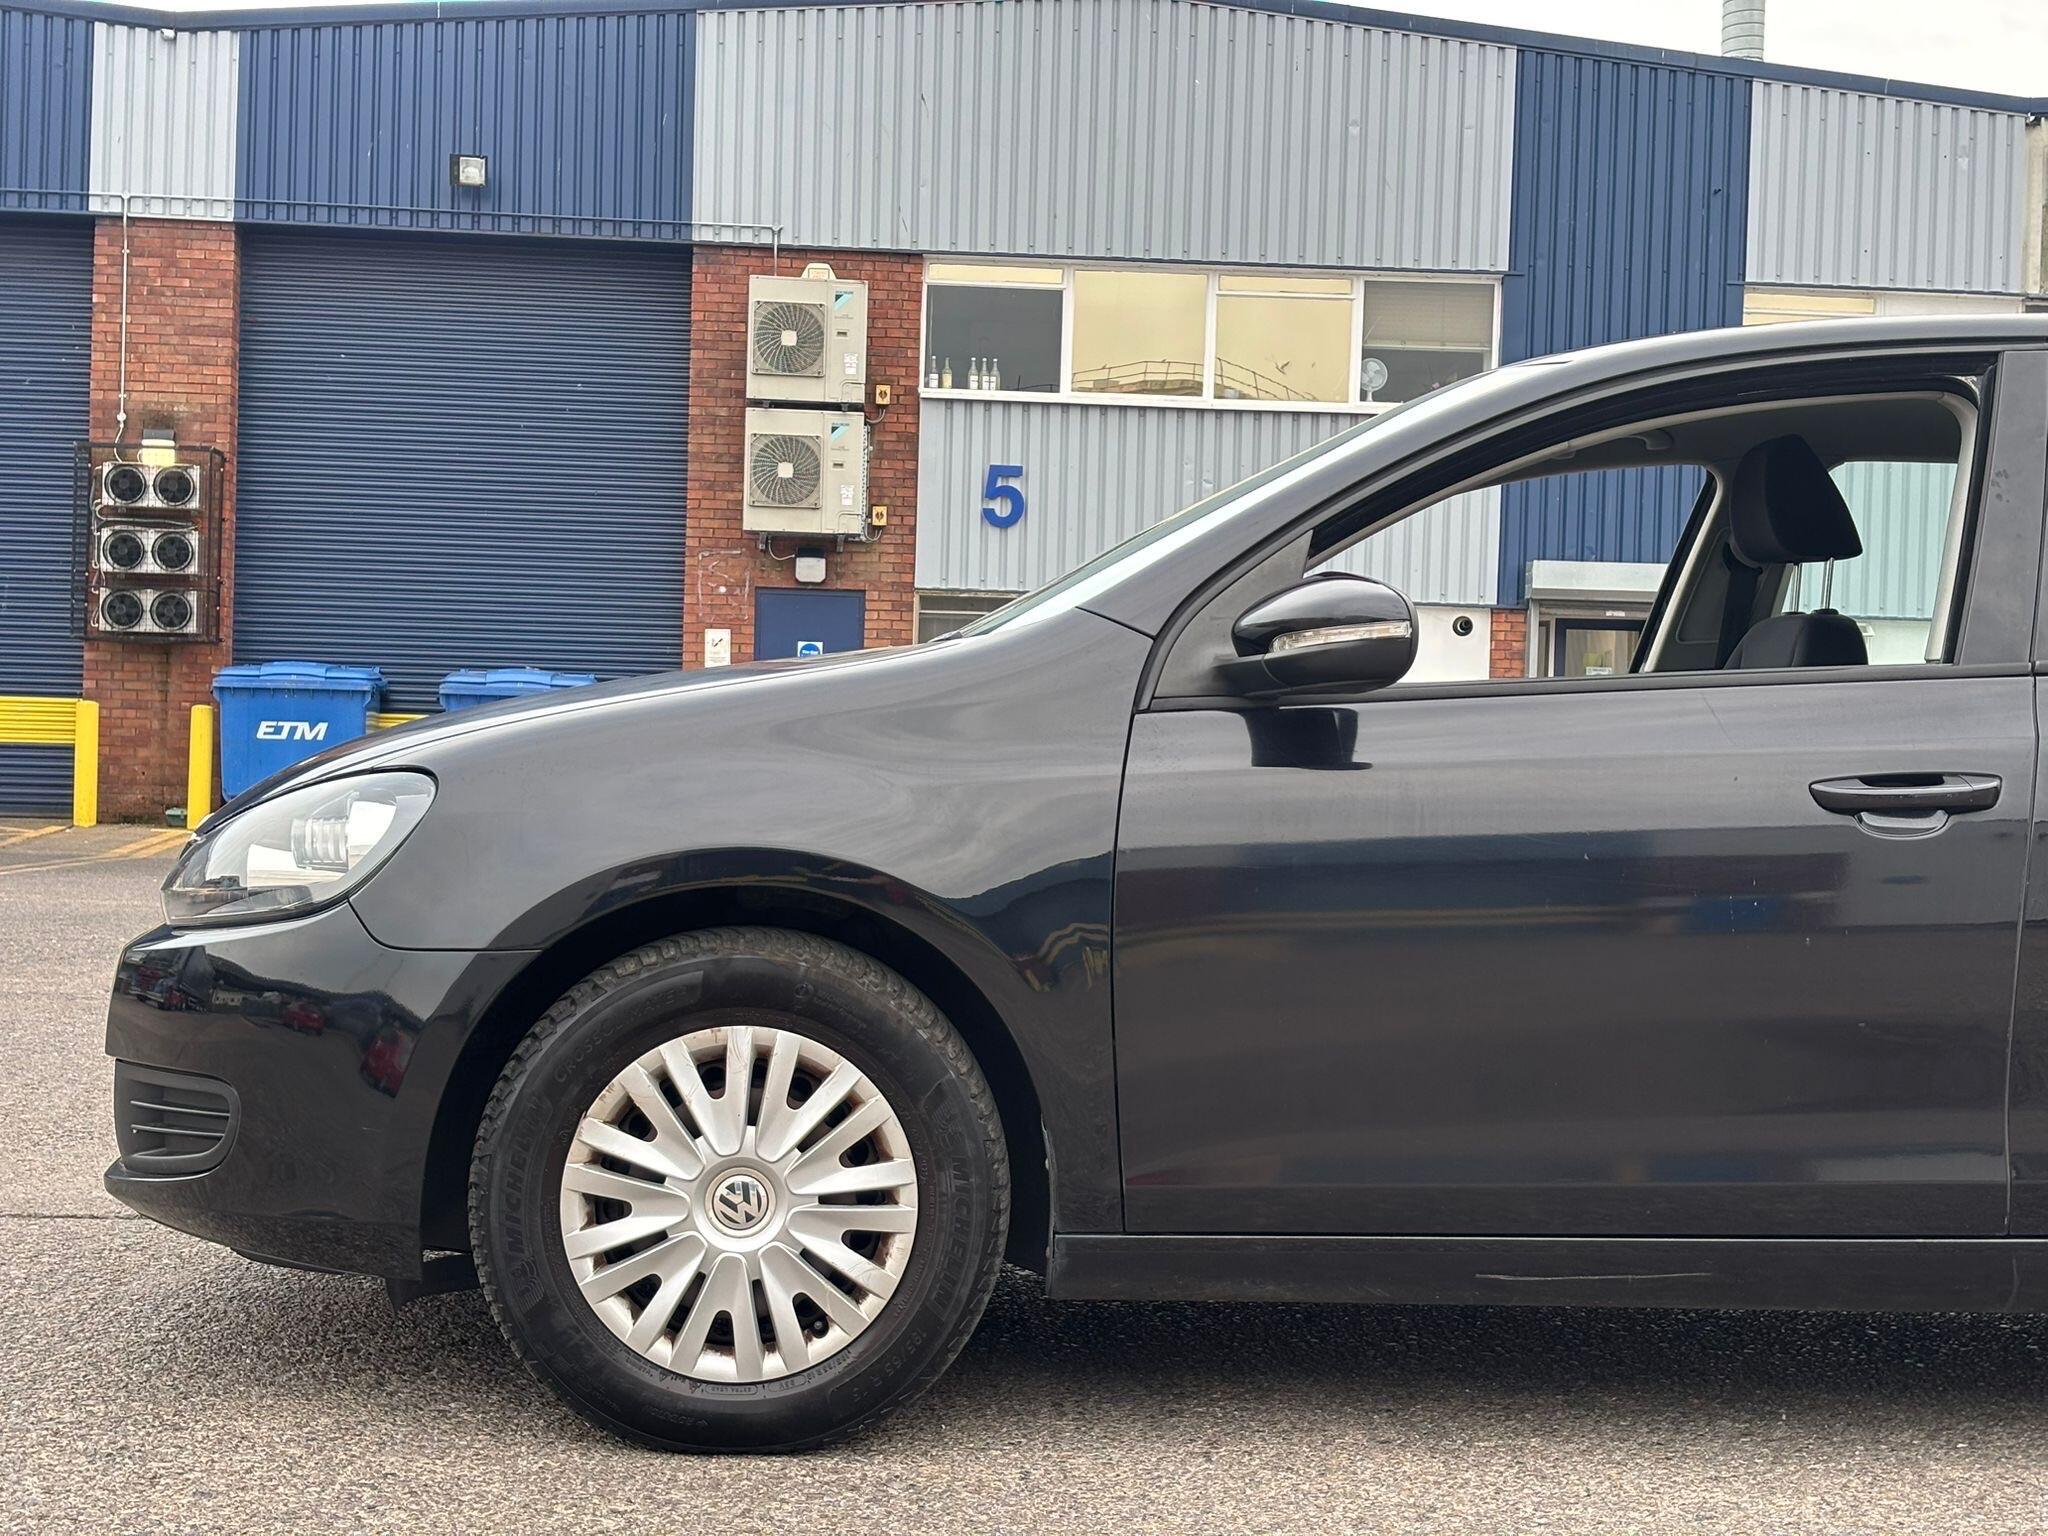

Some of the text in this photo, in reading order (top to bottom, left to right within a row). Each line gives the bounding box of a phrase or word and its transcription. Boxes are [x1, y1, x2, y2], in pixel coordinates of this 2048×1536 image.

[982, 464, 1025, 528] 5
[256, 721, 328, 740] ETM
[506, 1094, 547, 1256] MICHELIN
[713, 1175, 768, 1229] VW
[932, 1153, 969, 1309] MICHELIN
